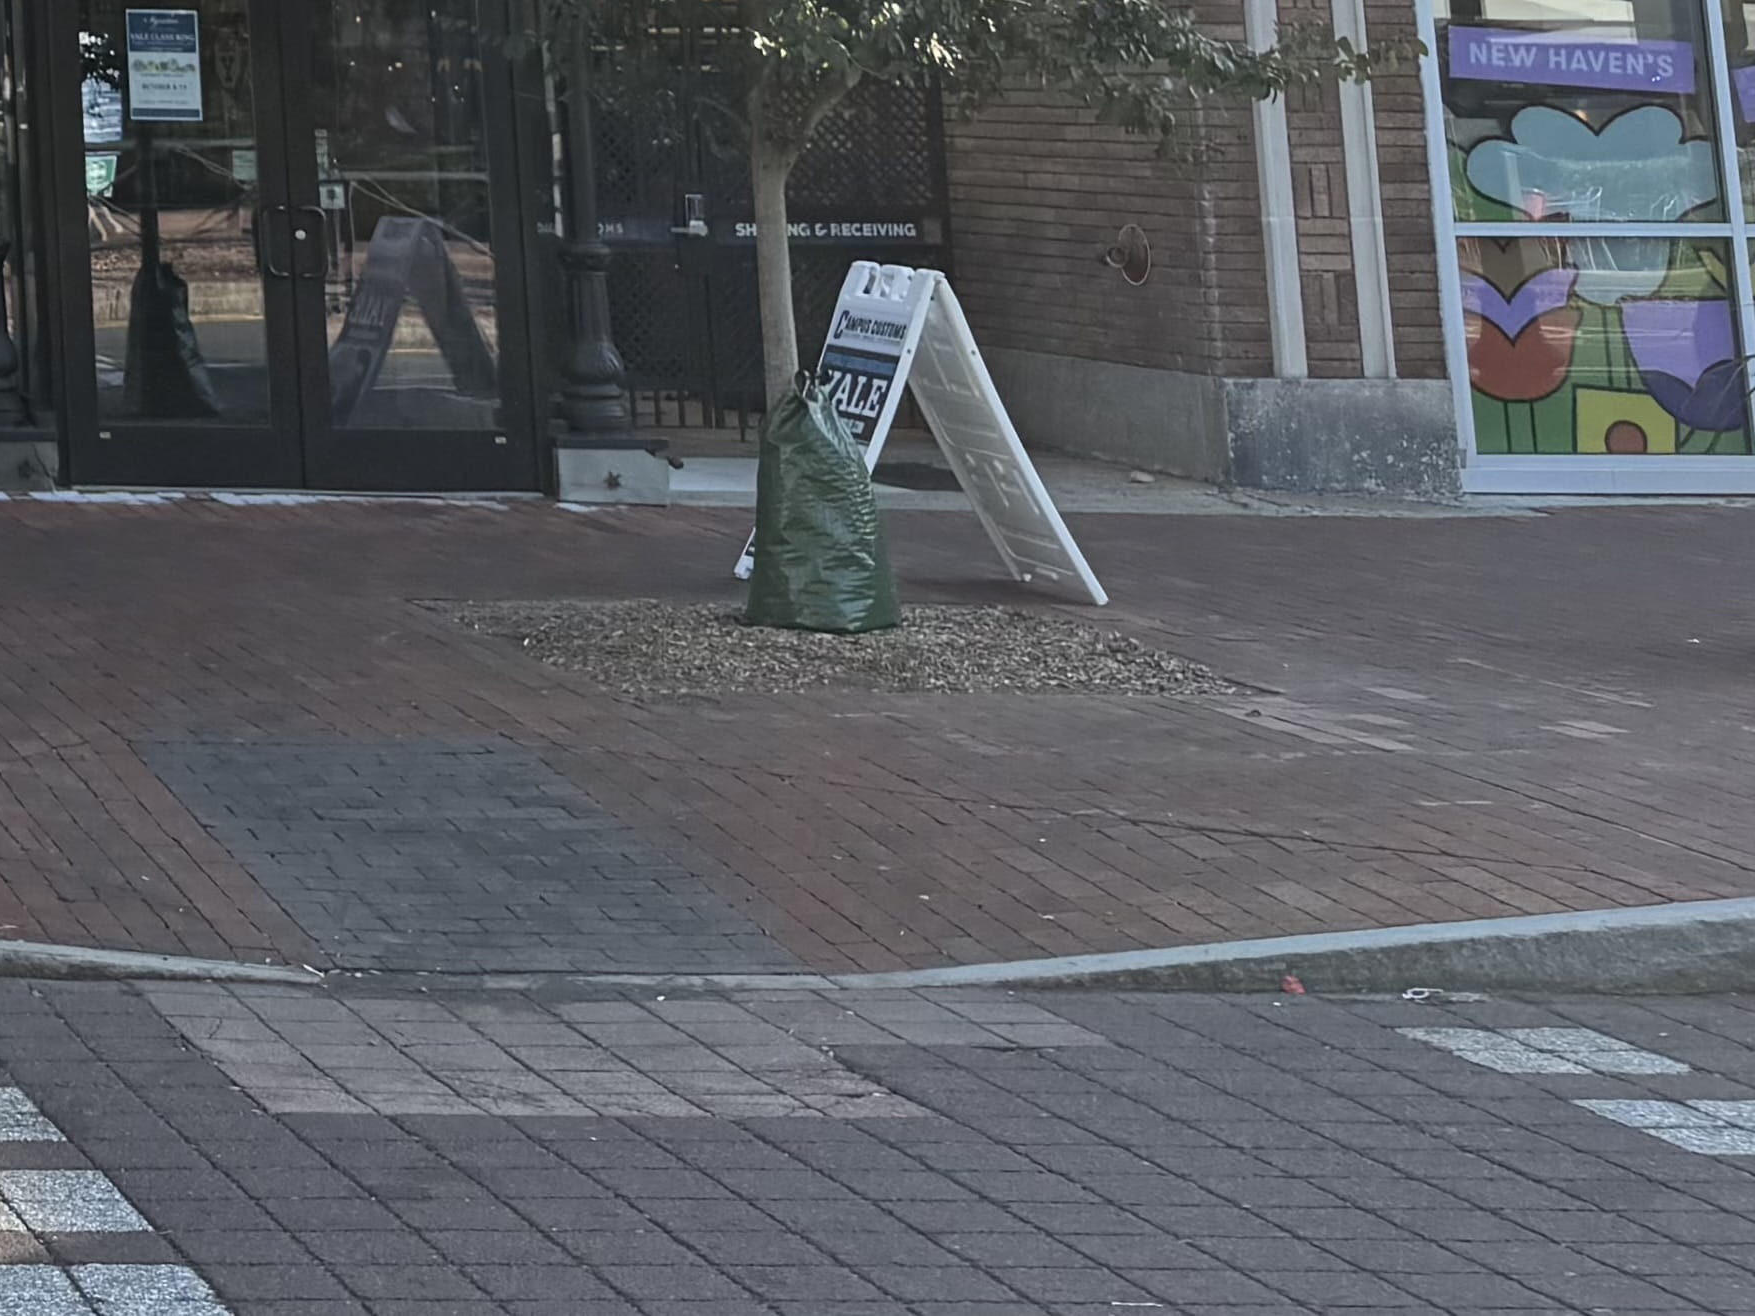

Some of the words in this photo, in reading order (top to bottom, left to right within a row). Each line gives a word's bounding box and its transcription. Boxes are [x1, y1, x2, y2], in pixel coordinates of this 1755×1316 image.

[1469, 42, 1538, 69] NEW
[1548, 46, 1675, 78] HAVEN'S
[735, 222, 811, 237] SHNG
[815, 223, 828, 236] &
[830, 222, 916, 237] RECEIVING
